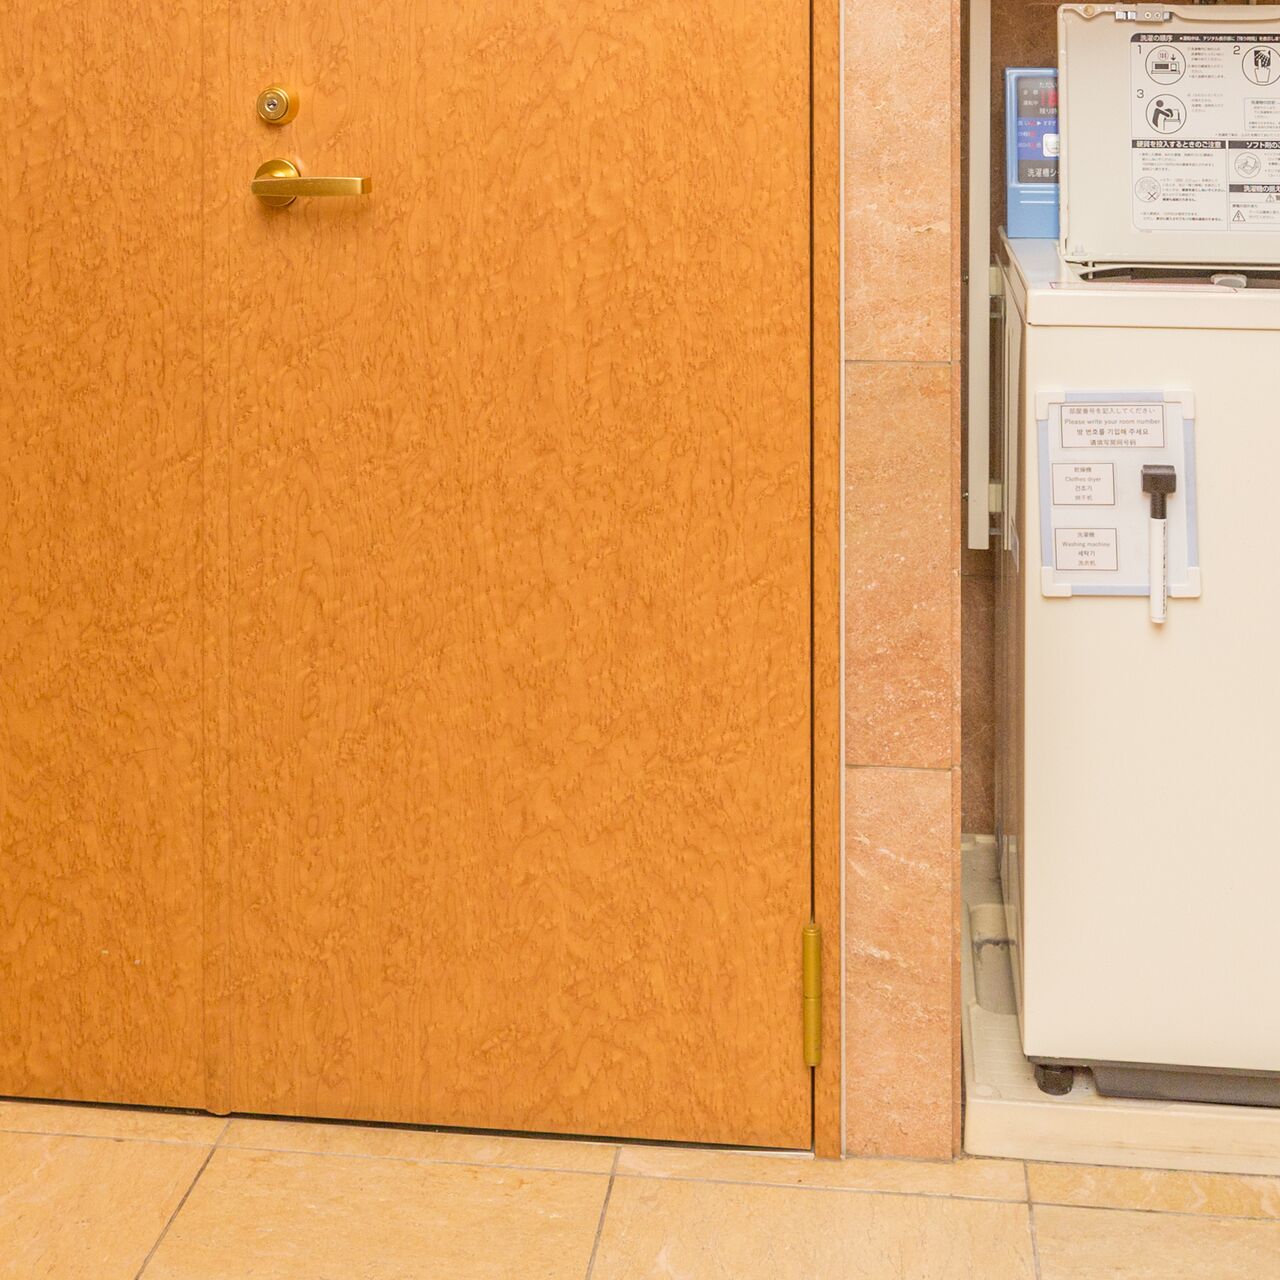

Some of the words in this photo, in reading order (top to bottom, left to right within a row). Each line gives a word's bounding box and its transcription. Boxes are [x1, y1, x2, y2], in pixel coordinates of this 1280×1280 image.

[1137, 44, 1142, 54] 1
[1233, 45, 1241, 55] 2
[1136, 88, 1144, 99] 3
[1128, 428, 1149, 436] 주세요
